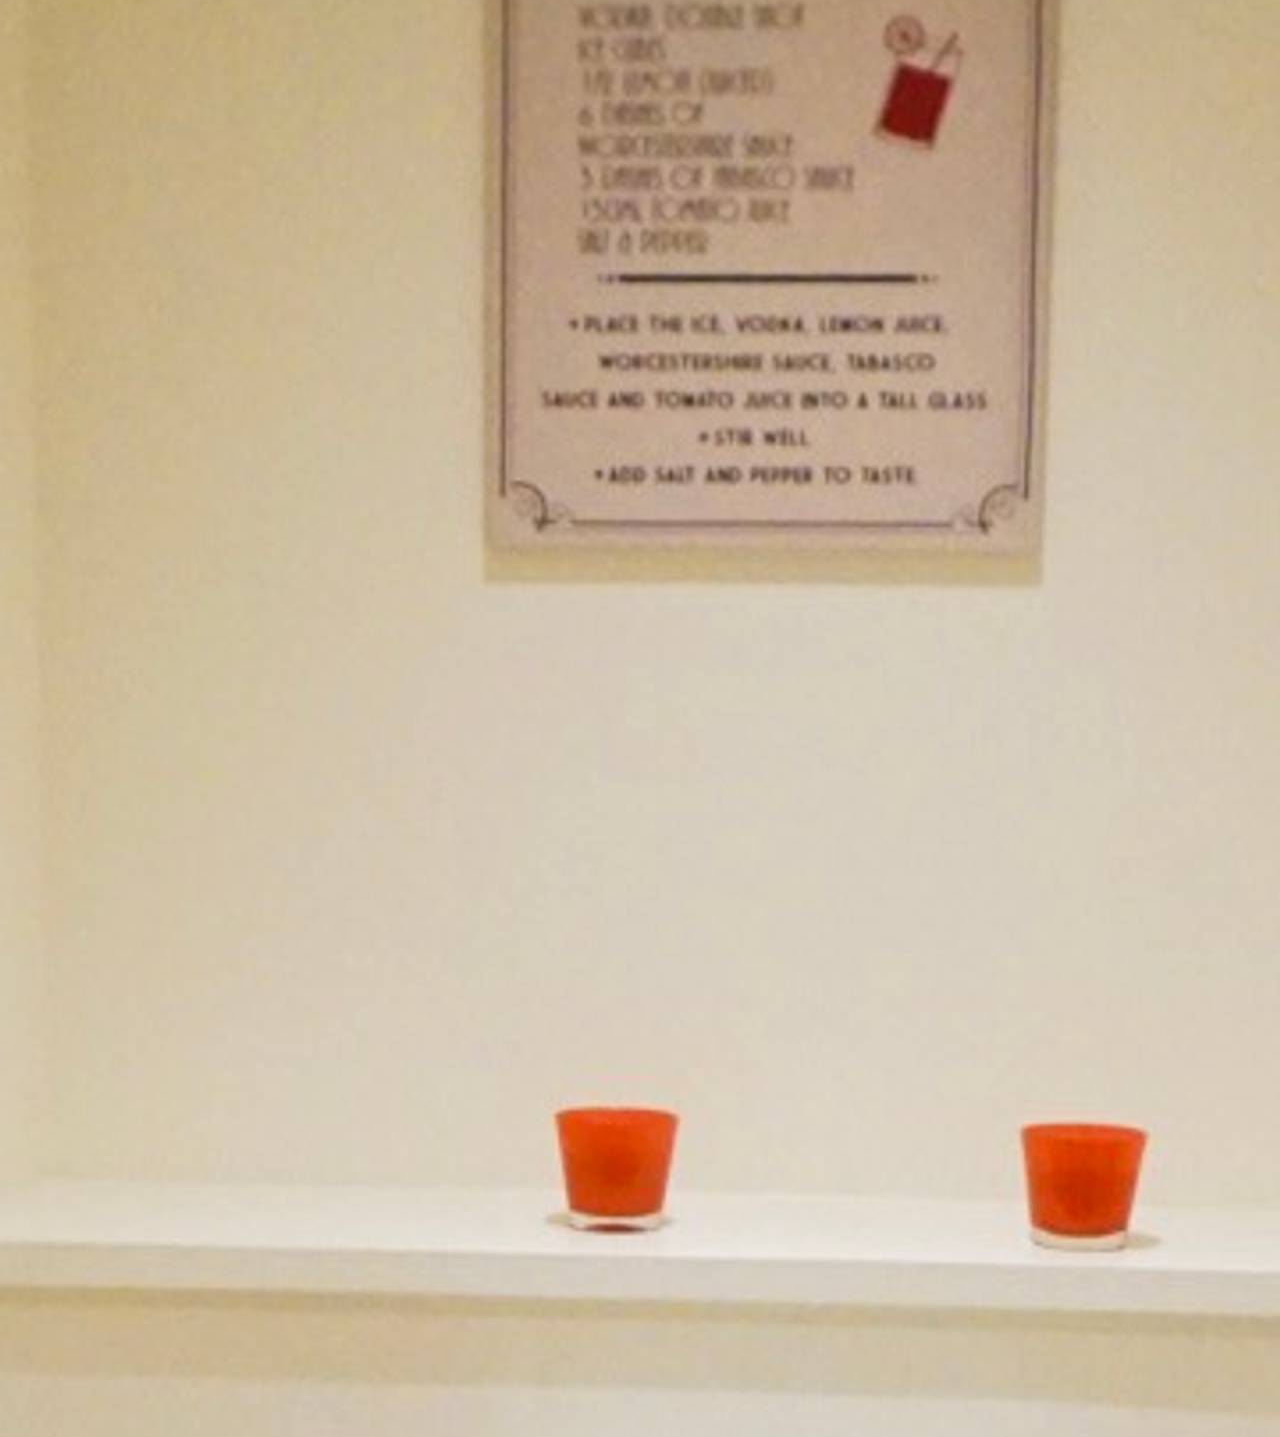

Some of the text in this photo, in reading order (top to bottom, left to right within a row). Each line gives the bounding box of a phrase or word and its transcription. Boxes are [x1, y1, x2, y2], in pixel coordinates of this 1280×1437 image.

[583, 316, 639, 334] PLACE
[649, 316, 682, 334] THE
[818, 316, 884, 334] LEMON
[599, 352, 763, 372] WORCESTERSHIRE
[848, 352, 937, 372] TABASCO
[541, 390, 987, 410] SAUCE AND TOMATO JUICE INTO A TALL GLASS
[714, 428, 753, 447] STIR
[608, 466, 646, 485] ADD
[655, 466, 695, 485] SALT
[705, 466, 743, 485] AND
[750, 466, 813, 485] PEPPER
[824, 466, 852, 485] TO
